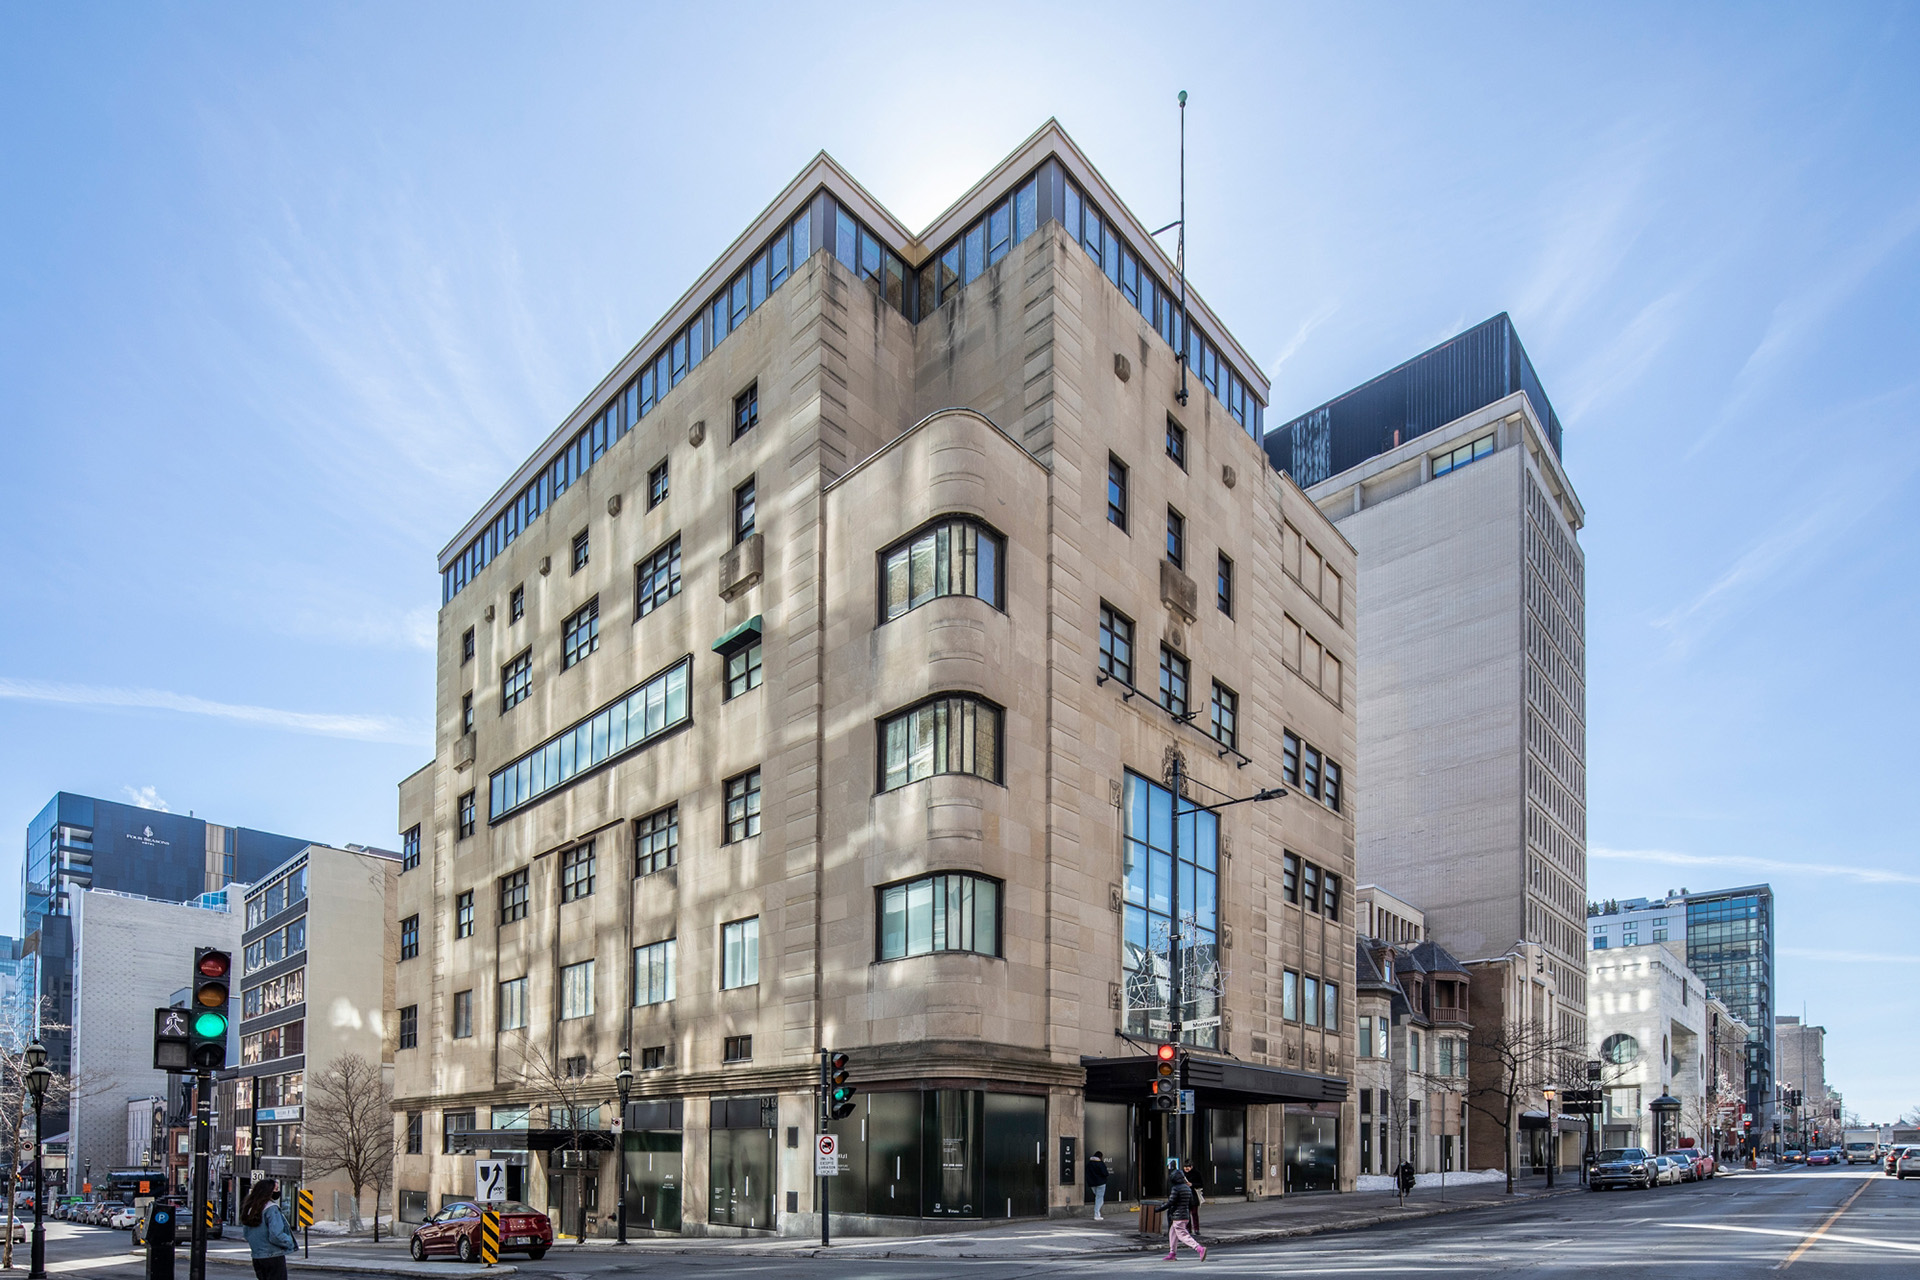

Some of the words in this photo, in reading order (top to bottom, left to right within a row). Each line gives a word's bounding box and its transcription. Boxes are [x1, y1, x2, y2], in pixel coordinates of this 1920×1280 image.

[126, 833, 143, 841] FOUR
[143, 837, 170, 846] SEASONS
[1192, 1020, 1219, 1028] Montagne
[252, 1172, 263, 1181] 30
